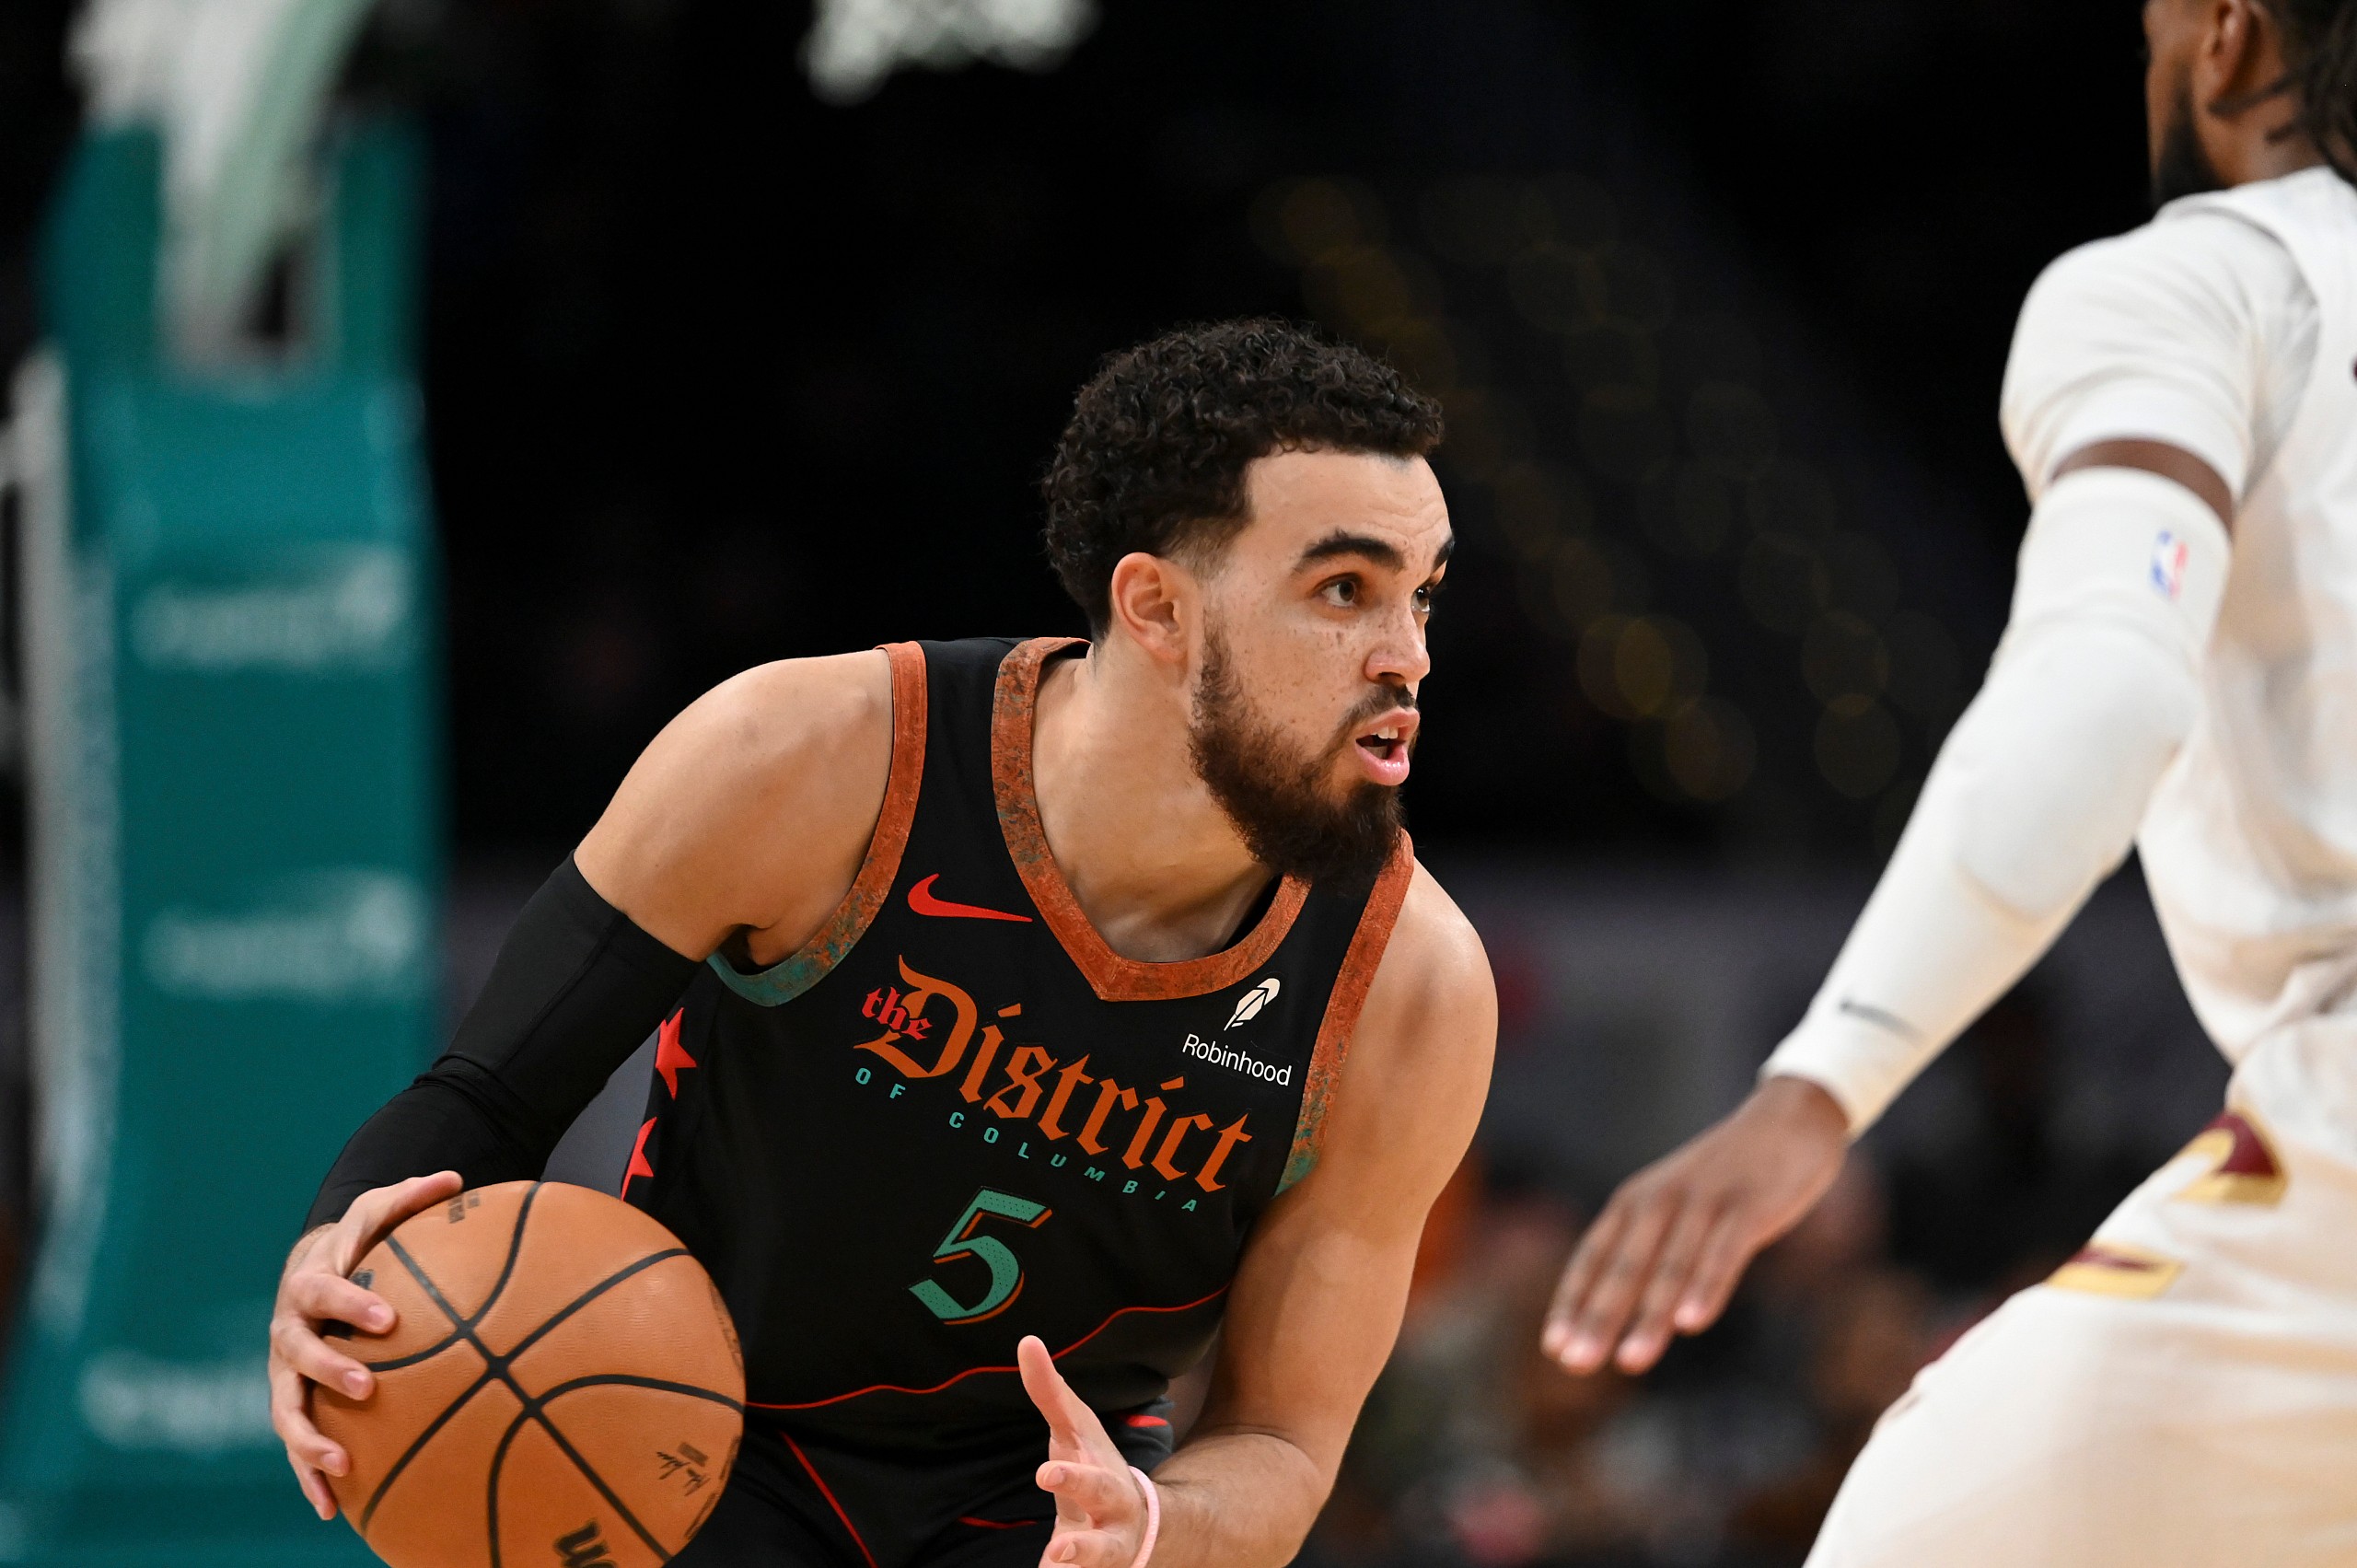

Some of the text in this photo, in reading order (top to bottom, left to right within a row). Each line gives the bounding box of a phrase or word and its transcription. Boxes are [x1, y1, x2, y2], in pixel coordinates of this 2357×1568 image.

[853, 954, 1253, 1193] the District
[1181, 1033, 1292, 1086] Robinhood
[854, 1066, 1199, 1213] OF COLUMBIA
[906, 1186, 1053, 1326] 5
